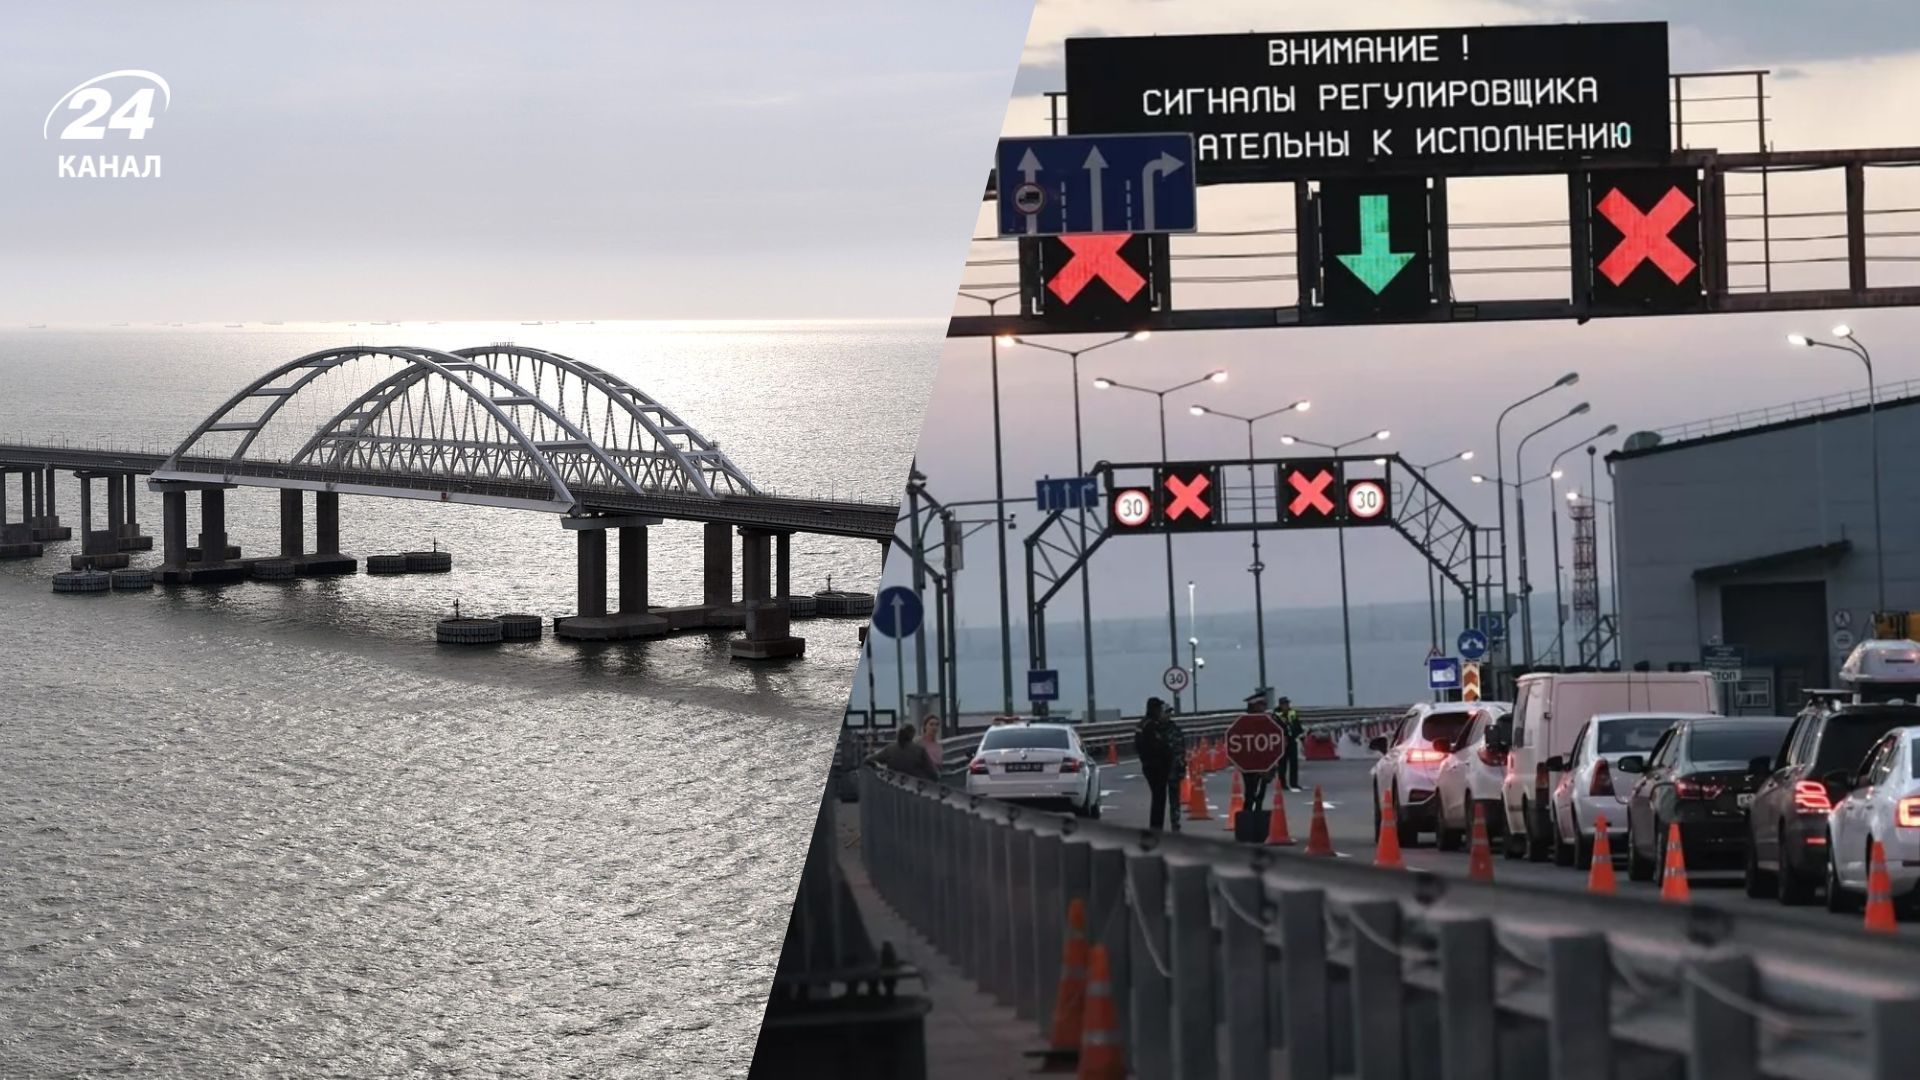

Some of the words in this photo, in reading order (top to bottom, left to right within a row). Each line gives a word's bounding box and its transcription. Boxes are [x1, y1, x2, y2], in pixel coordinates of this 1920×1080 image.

[1267, 34, 1440, 67] ВНИМАНИЕ
[1462, 34, 1470, 61] !
[1142, 85, 1297, 116] СИГНАЛЫ
[1319, 76, 1599, 111] РЕГУЛИРОВЩИКА
[1198, 130, 1351, 161] АТЕЛЬНЫ
[1373, 128, 1394, 156] К
[1416, 121, 1632, 155] ИСПОЛНЕНИЮ
[1122, 498, 1143, 517] 30
[1356, 490, 1377, 509] 30
[1168, 673, 1184, 685] 30
[1229, 733, 1281, 753] STOP
